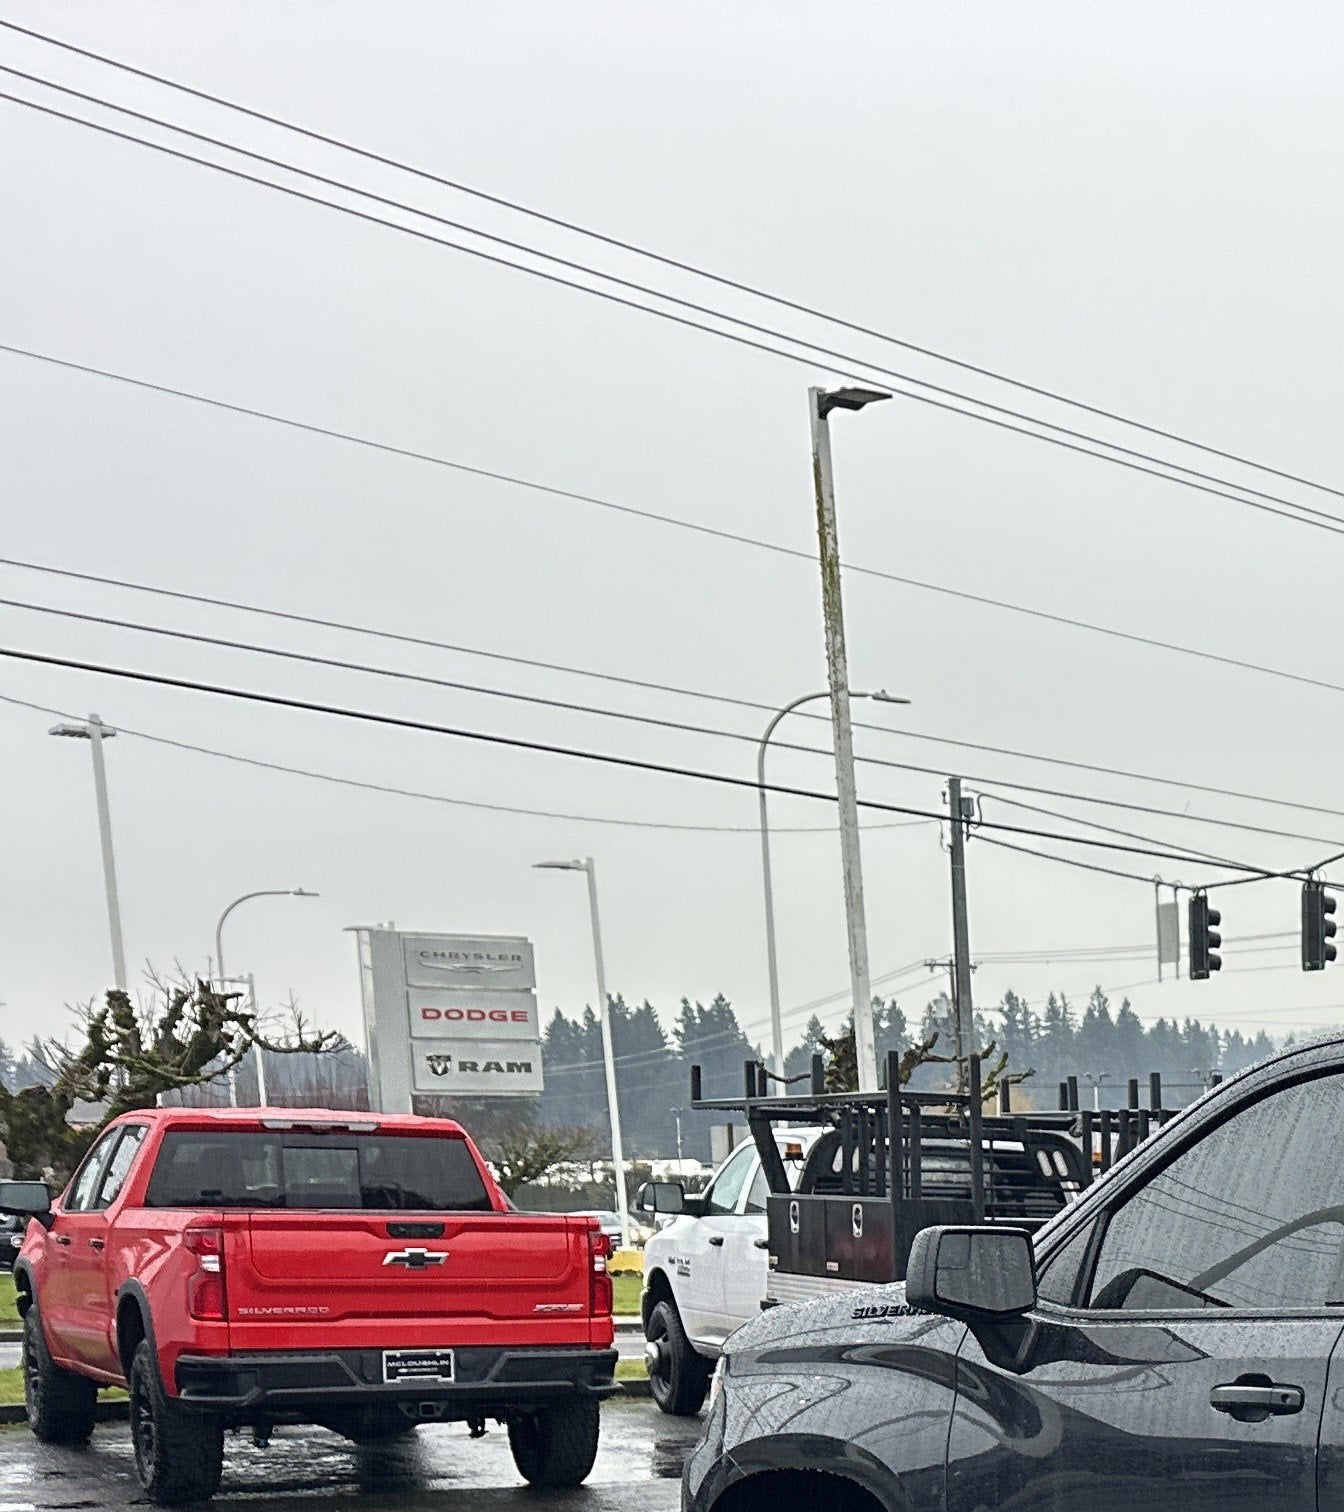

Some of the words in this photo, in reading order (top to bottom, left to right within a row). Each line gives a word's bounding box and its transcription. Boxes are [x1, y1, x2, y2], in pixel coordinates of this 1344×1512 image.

[419, 951, 522, 962] CHRYSLER
[421, 1008, 529, 1022] DODGE
[458, 1061, 532, 1073] RAM
[238, 1306, 330, 1315] SILVERADO
